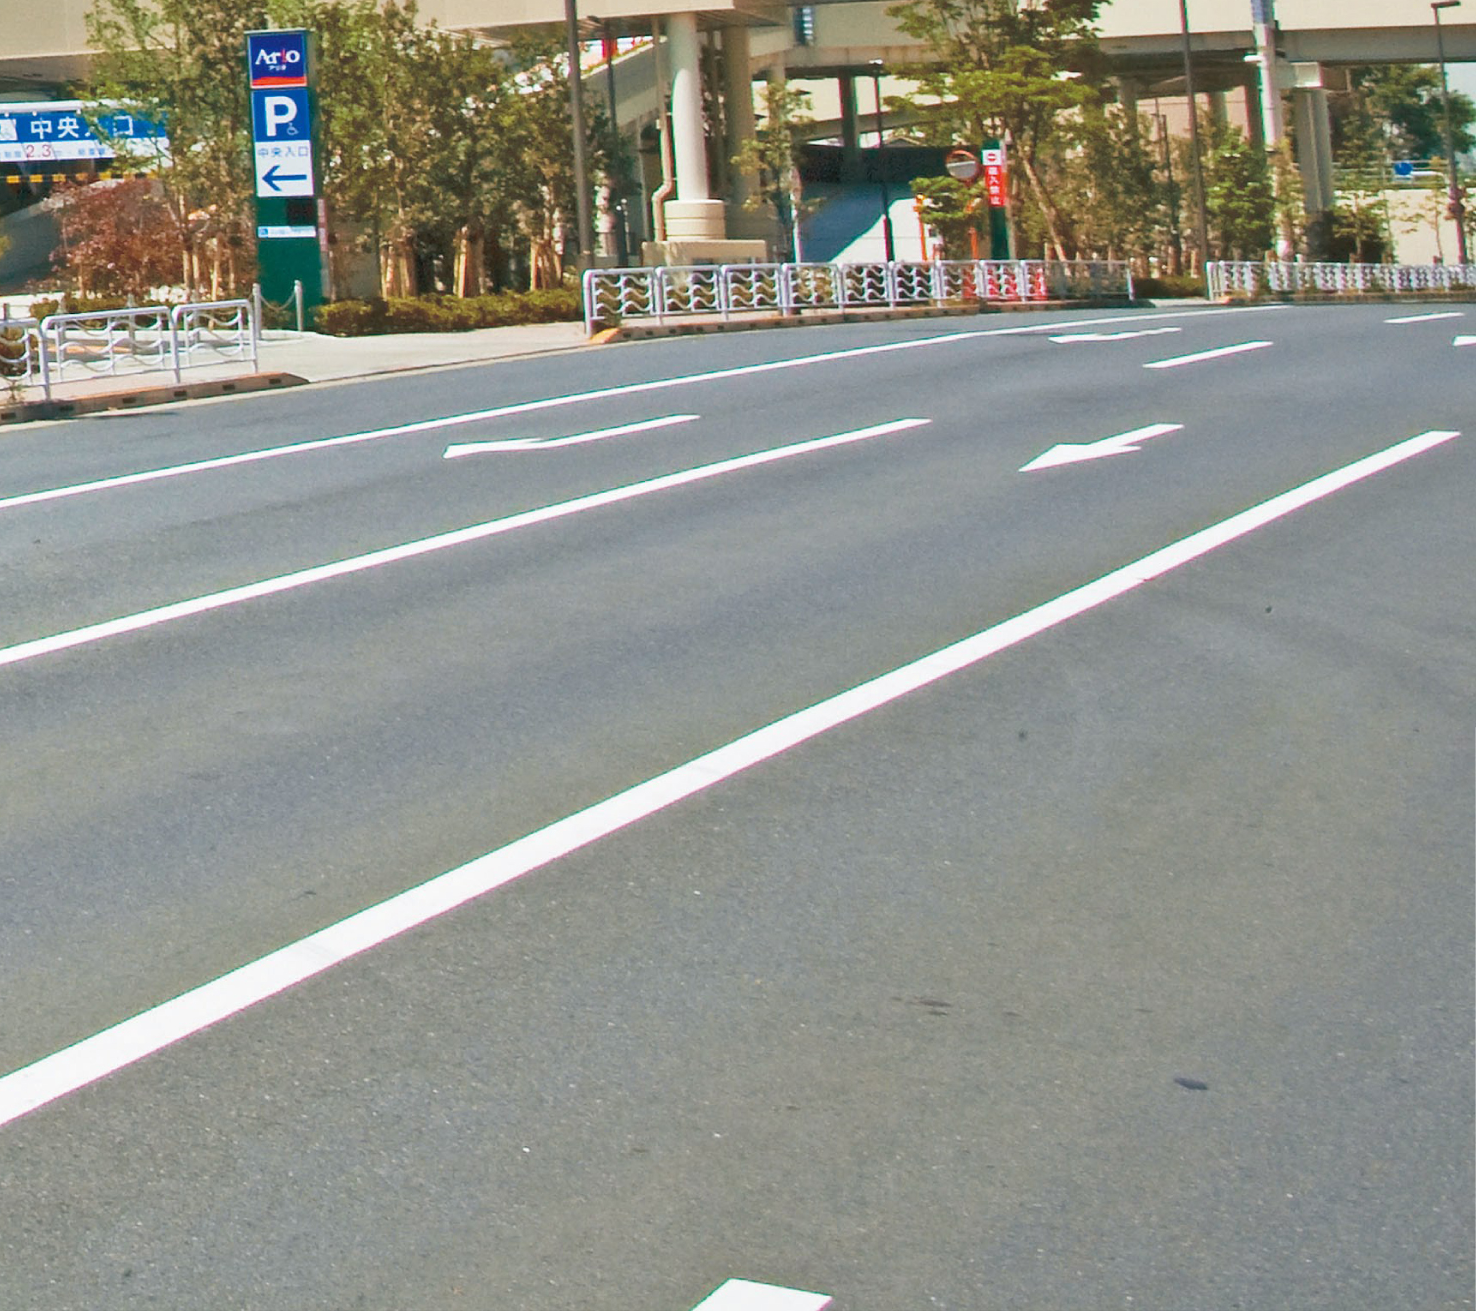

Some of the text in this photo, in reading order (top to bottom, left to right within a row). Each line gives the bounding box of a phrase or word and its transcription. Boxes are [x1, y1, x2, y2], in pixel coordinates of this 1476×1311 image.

[254, 47, 301, 65] Ario
[264, 95, 298, 137] P
[258, 146, 309, 159] 中央入口
